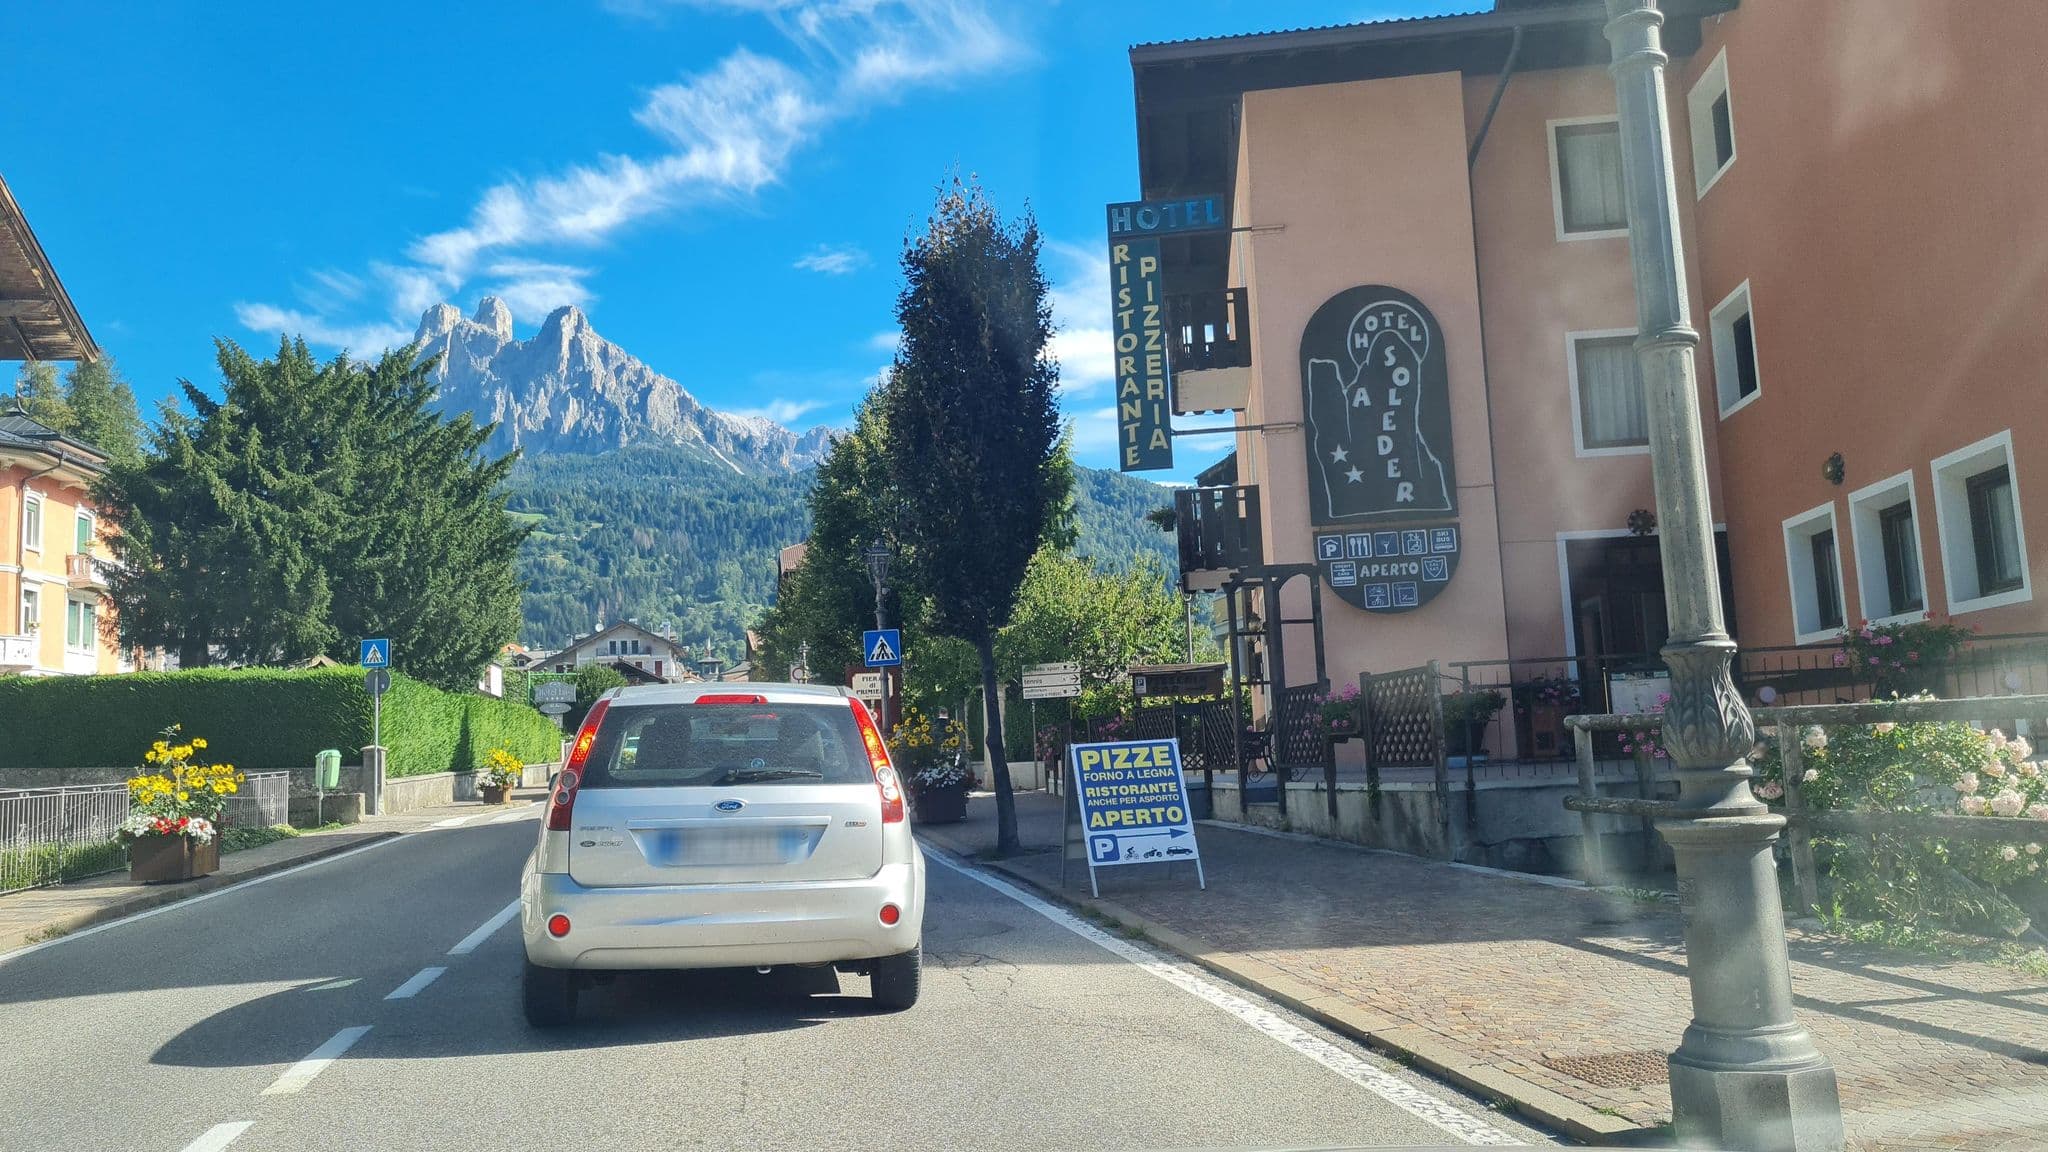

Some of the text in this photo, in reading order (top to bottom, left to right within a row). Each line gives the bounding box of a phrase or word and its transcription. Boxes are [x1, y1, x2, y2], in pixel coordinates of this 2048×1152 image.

[1111, 200, 1221, 233] HOTEL
[1354, 311, 1422, 349] HOTEL
[1113, 244, 1141, 466] RISTORANTE
[1140, 256, 1168, 450] PIZZERIA
[1326, 544, 1337, 557] P
[1360, 562, 1419, 578] APERTO
[1080, 746, 1172, 771] PIZZE
[1083, 768, 1175, 782] FORNO A LEGNA
[1085, 782, 1178, 798] RISTORANTE
[1087, 794, 1179, 807] ANCHE PER ASPORTO
[1090, 806, 1184, 828] APERTO
[1094, 838, 1114, 859] P
